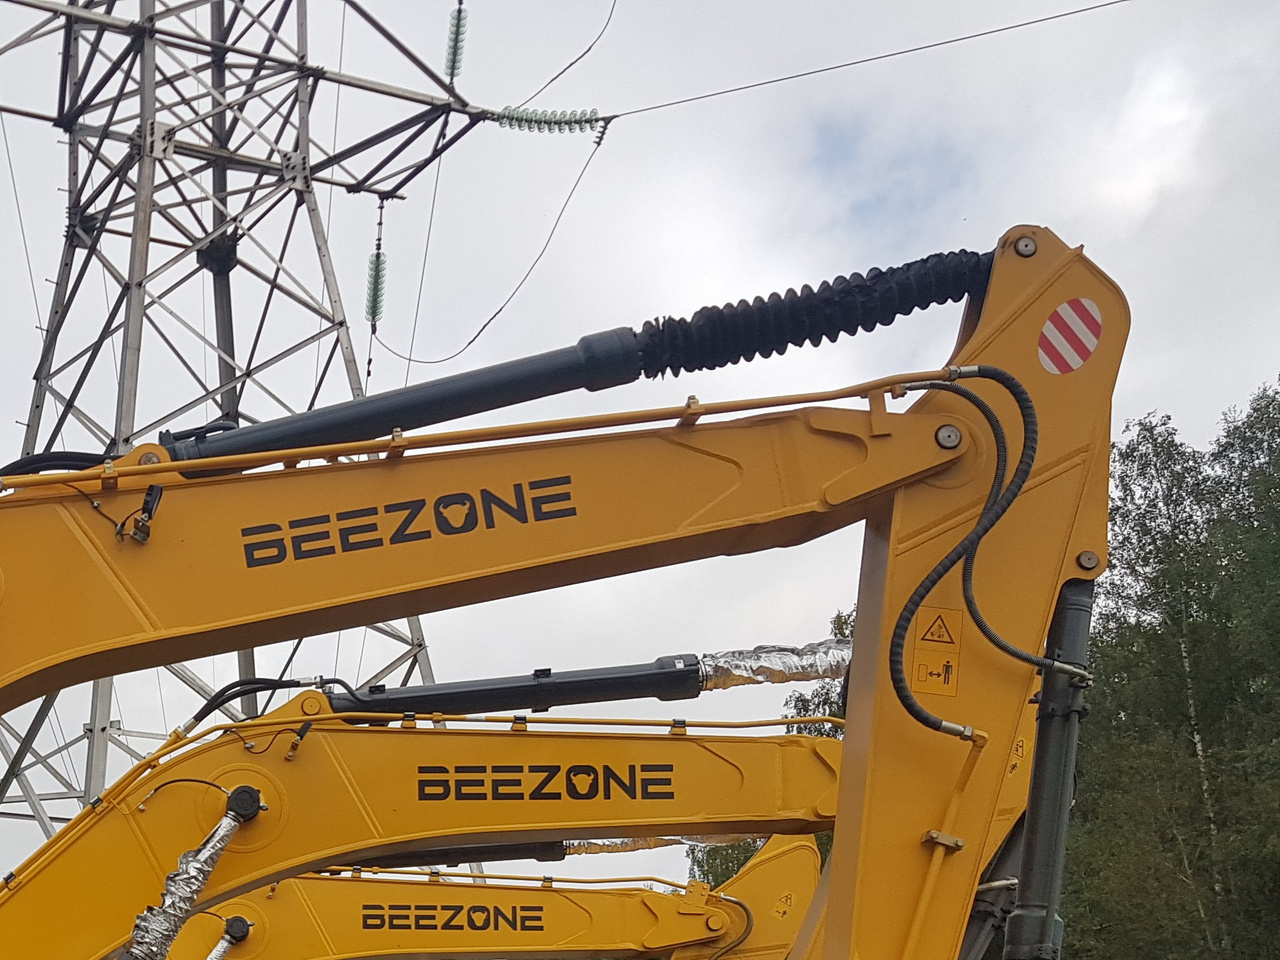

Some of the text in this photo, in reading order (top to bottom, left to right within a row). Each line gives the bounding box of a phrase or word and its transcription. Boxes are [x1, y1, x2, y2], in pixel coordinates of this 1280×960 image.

[241, 476, 577, 568] BEEZONE
[417, 764, 675, 801] BEEZONE
[362, 904, 544, 932] BEEZONE
